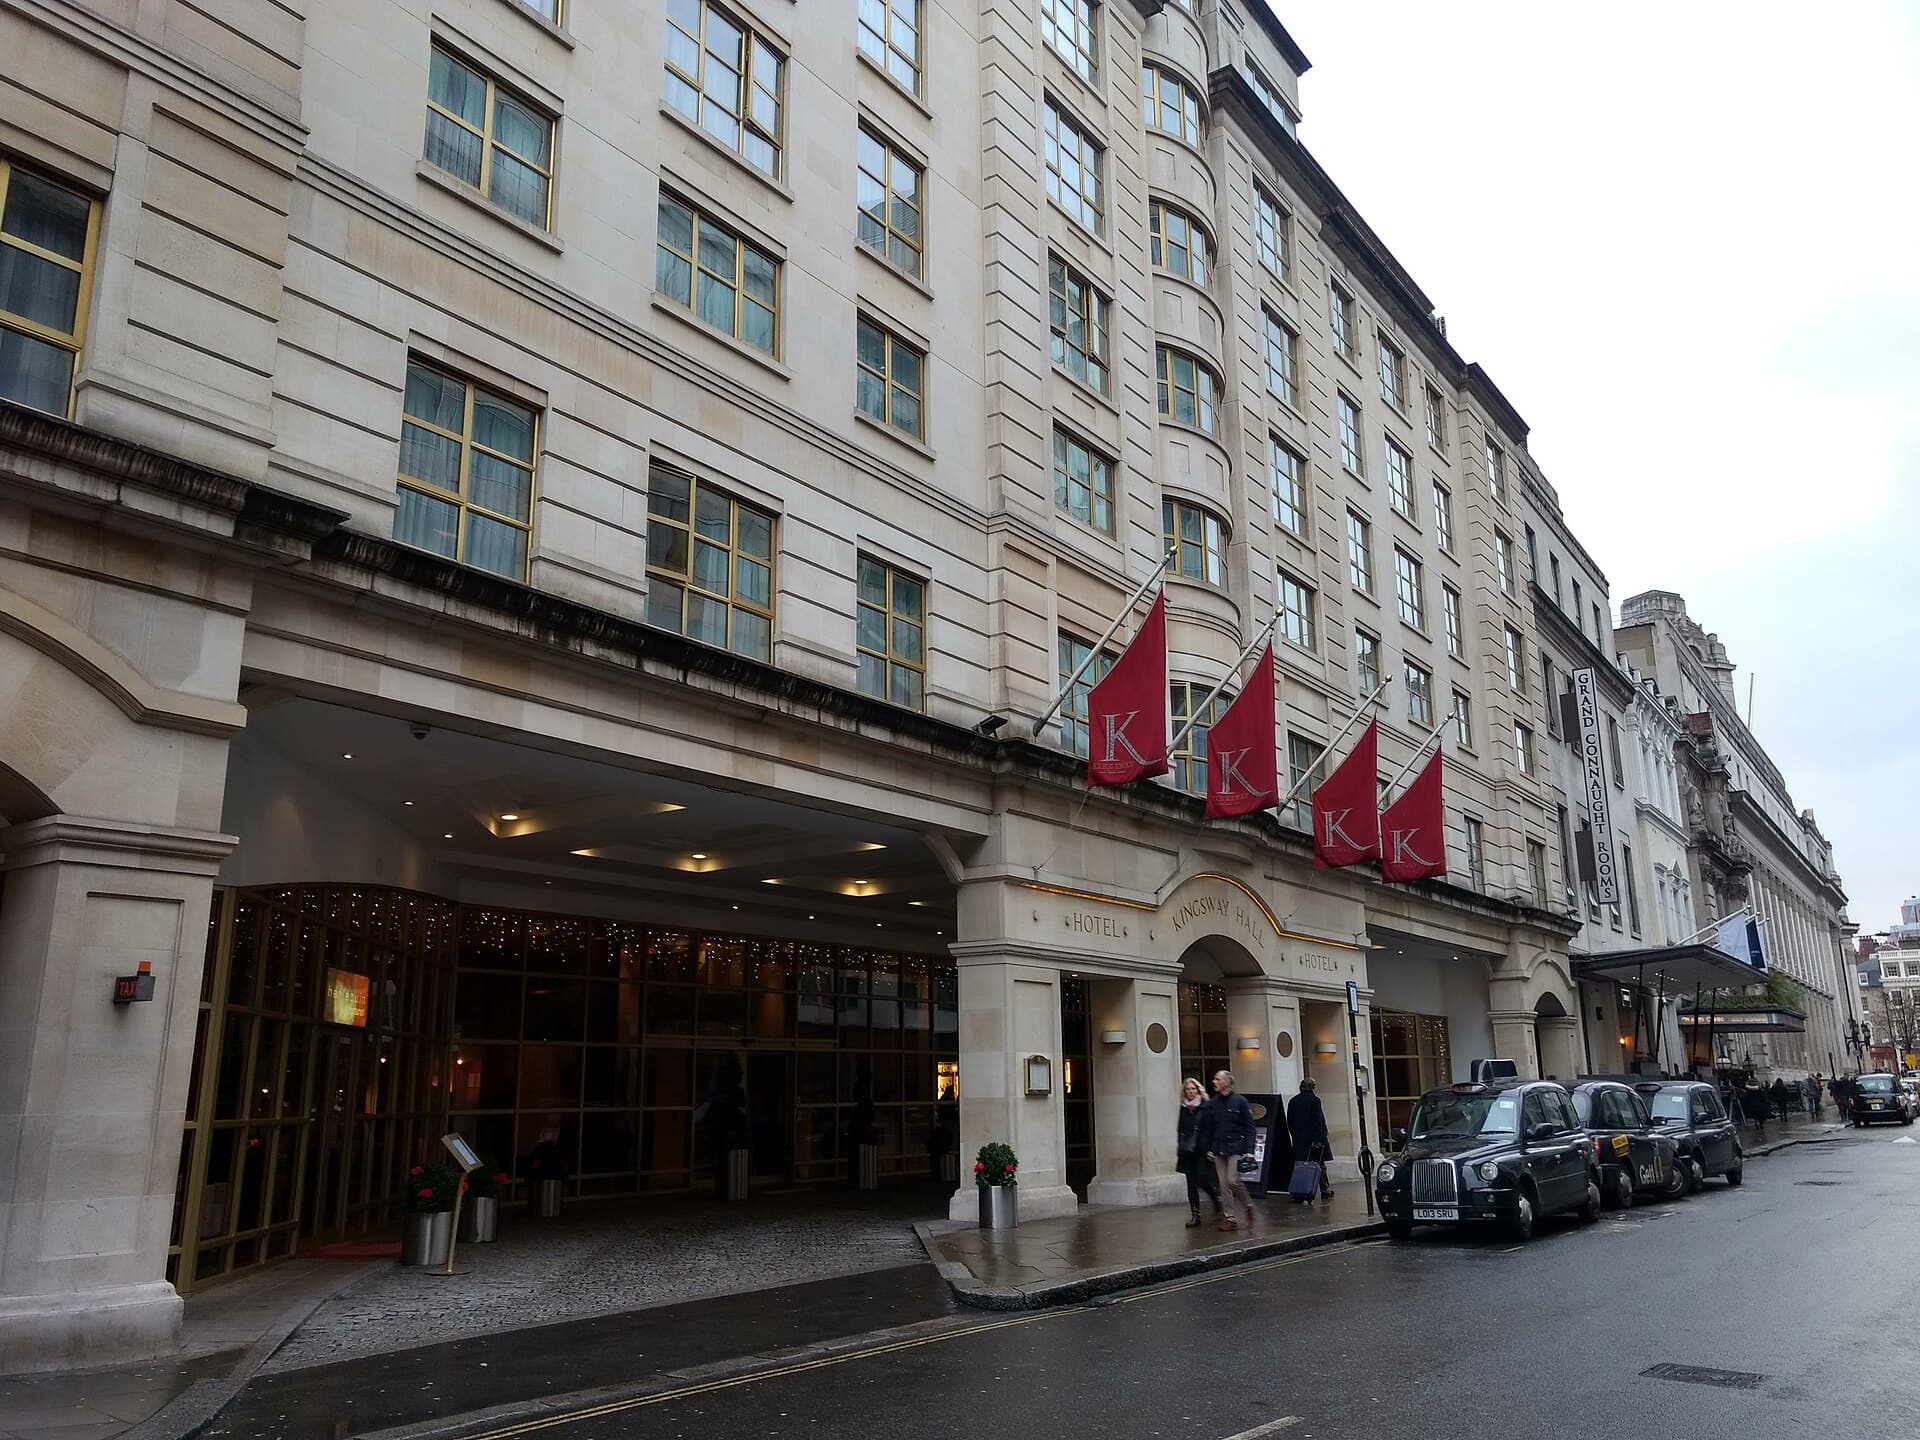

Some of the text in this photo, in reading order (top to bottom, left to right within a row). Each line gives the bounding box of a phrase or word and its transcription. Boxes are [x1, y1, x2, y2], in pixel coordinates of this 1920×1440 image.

[1099, 710, 1162, 765] K
[1215, 746, 1272, 798] K
[1578, 673, 1614, 898] GRAND CONNAUGHT ROOMS
[1321, 807, 1375, 851] K
[1389, 827, 1441, 867] K
[1073, 912, 1121, 938] HOTEL
[1171, 895, 1265, 949] KINGSWAY HALL
[1304, 951, 1334, 972] HOTEL
